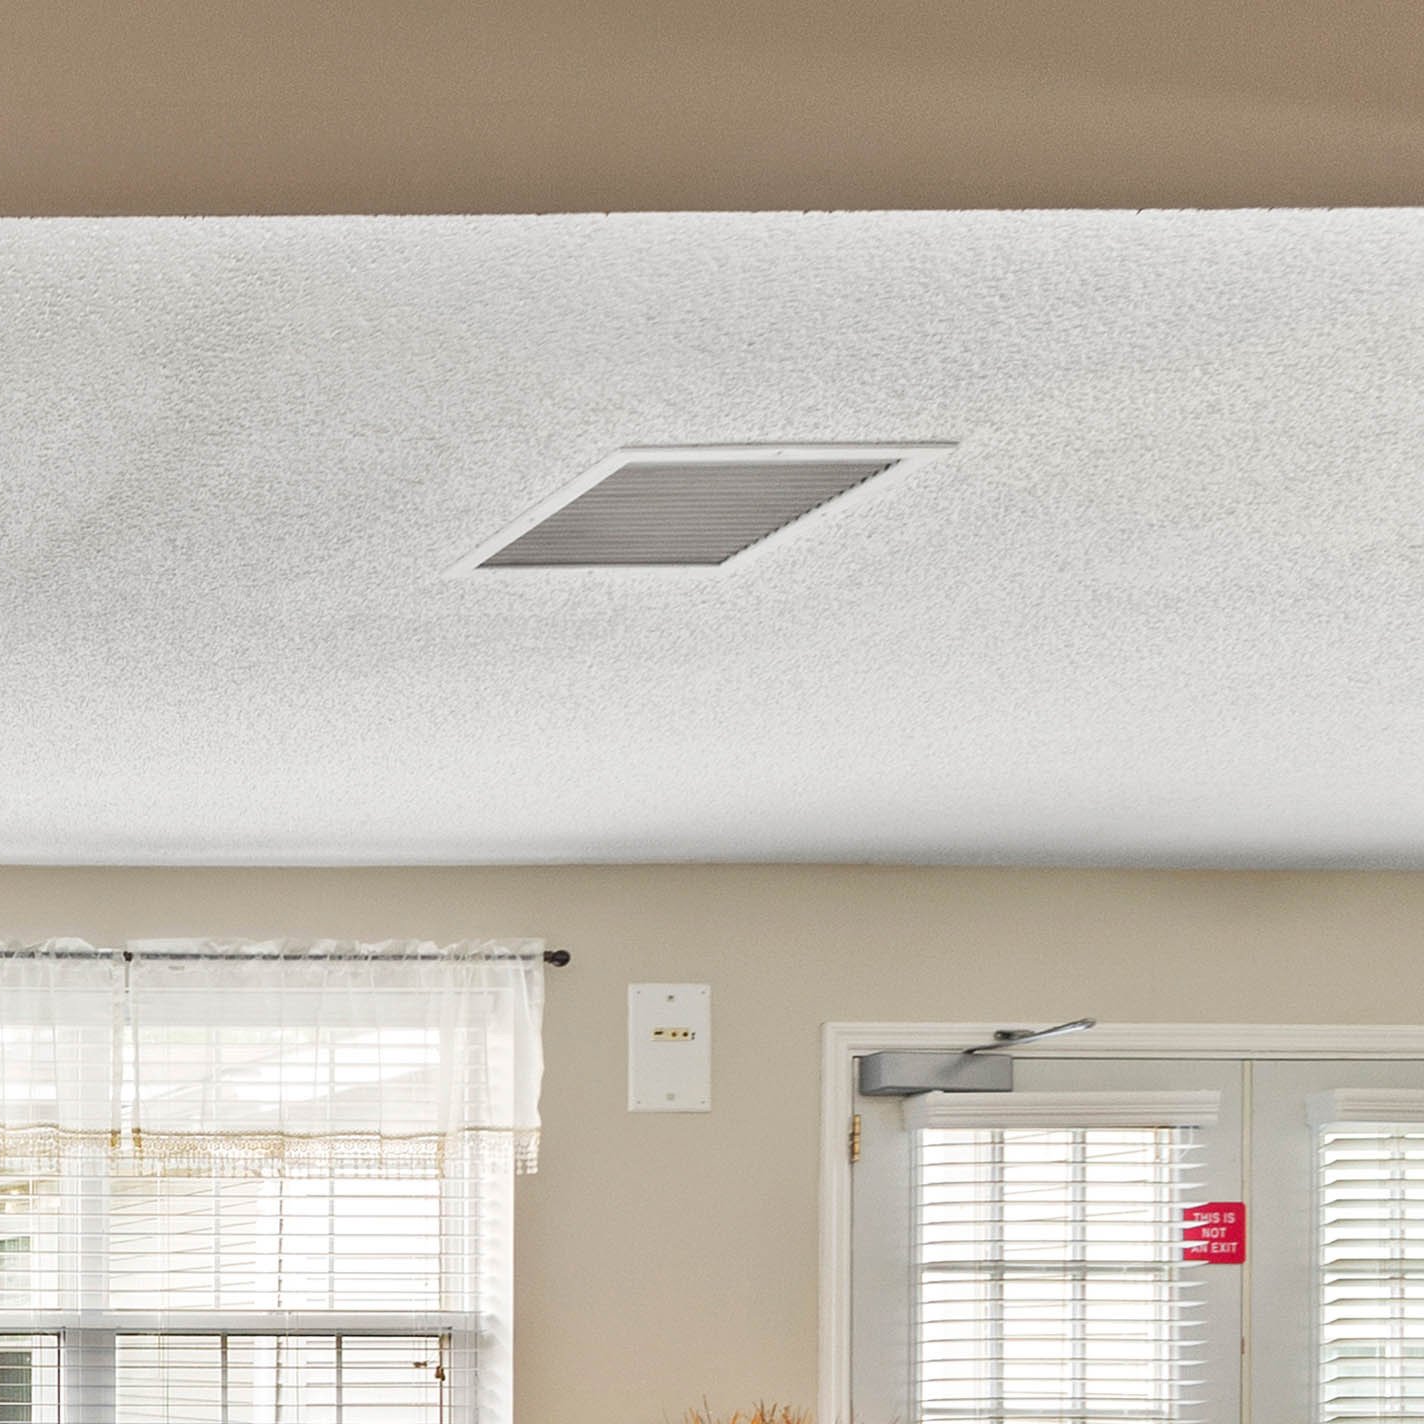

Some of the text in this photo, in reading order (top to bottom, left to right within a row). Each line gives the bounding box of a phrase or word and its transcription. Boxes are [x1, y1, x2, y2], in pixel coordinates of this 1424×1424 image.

[1193, 1212, 1236, 1224] THIS IS
[1201, 1226, 1227, 1239] NOT
[1211, 1242, 1238, 1254] EXIT
